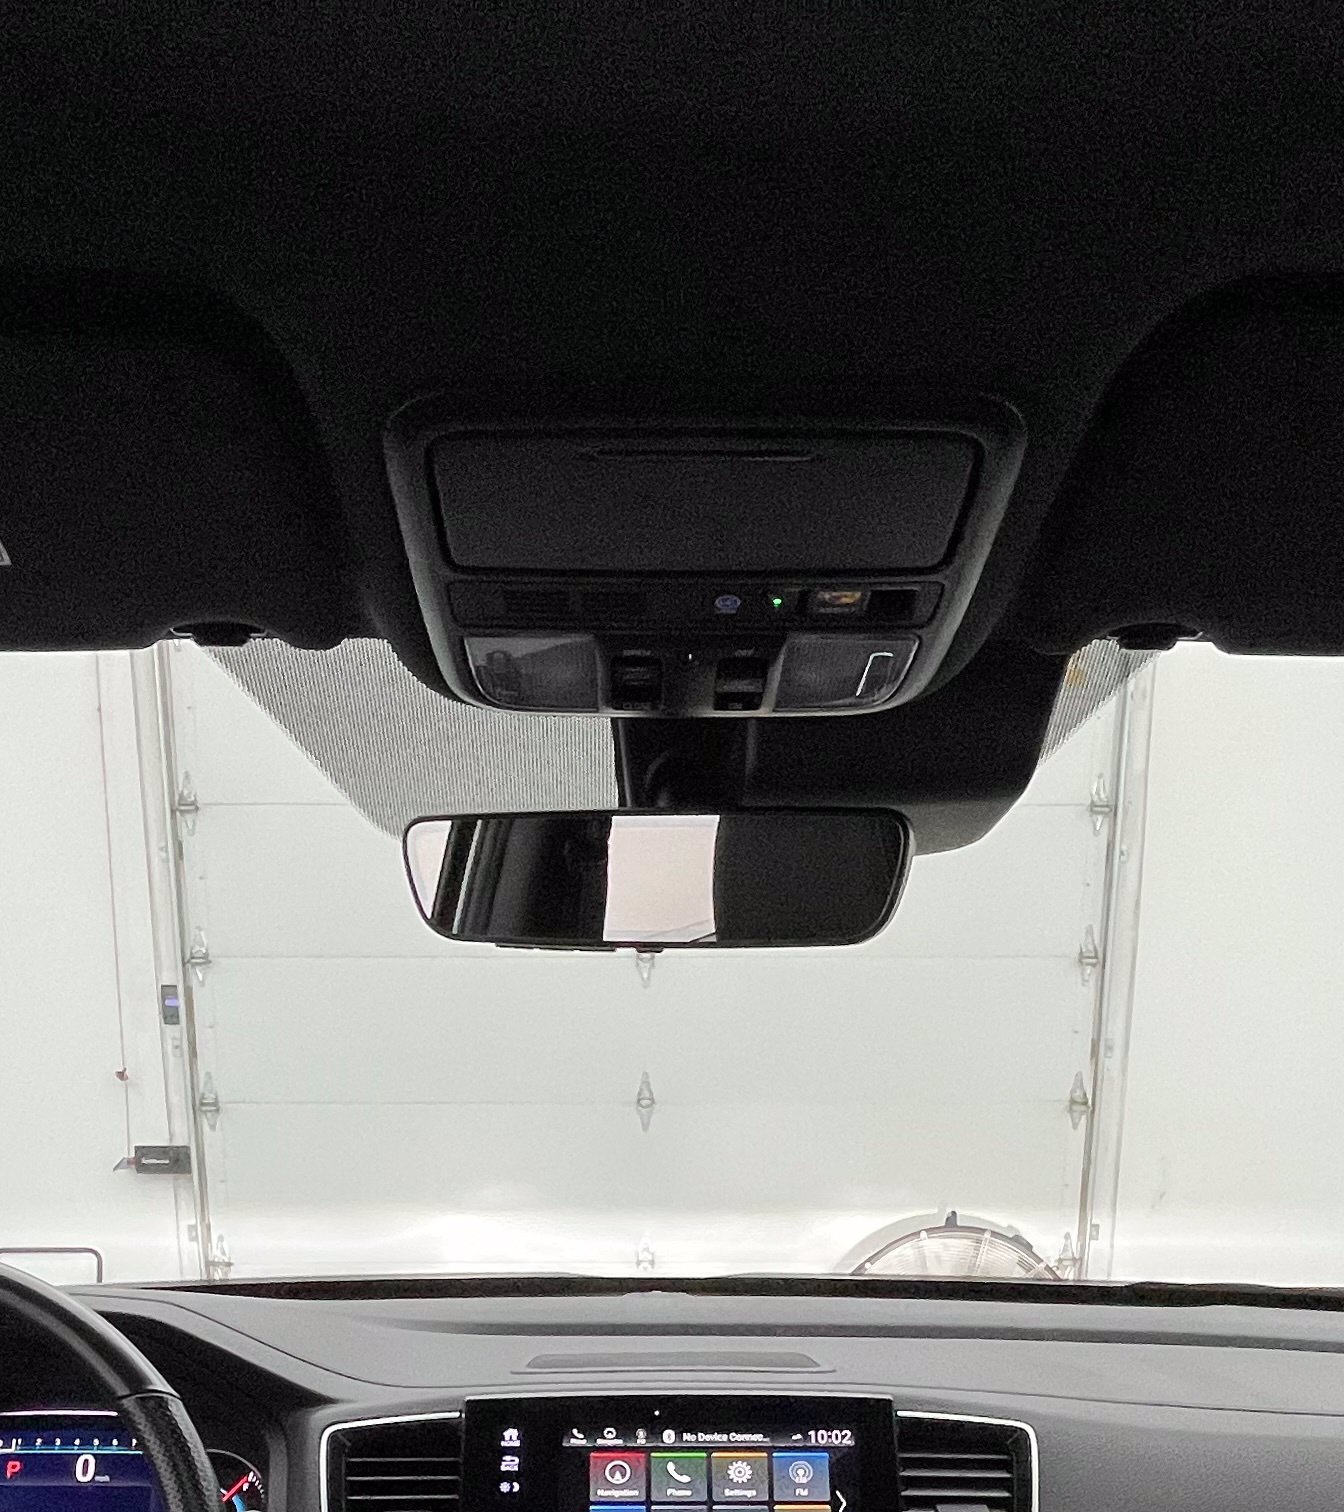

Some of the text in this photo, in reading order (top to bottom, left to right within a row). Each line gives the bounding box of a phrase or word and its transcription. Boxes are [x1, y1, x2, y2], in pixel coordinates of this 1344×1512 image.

[698, 1432, 728, 1442] Device
[808, 1429, 852, 1445] 10:02
[6, 1460, 22, 1480] P
[75, 1453, 97, 1484] 0
[597, 1488, 639, 1498] Navigation
[667, 1488, 692, 1497] Phone
[724, 1488, 756, 1498] Settings
